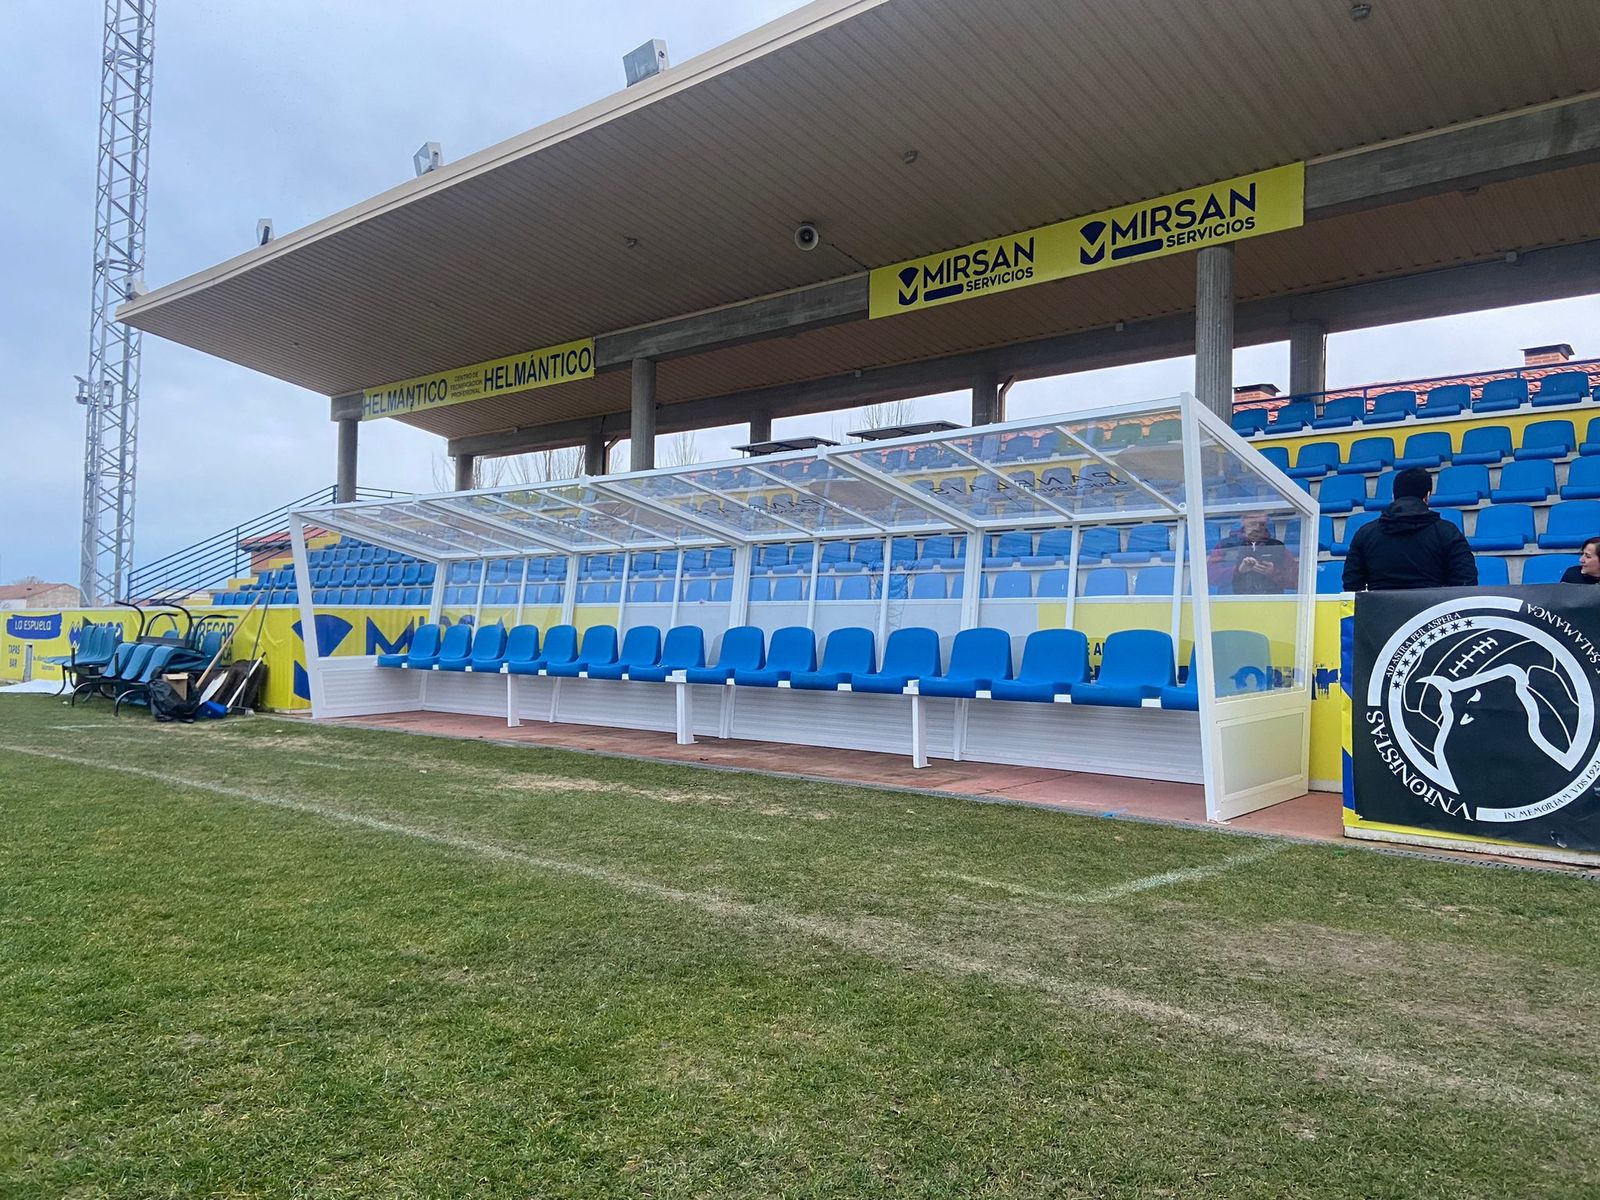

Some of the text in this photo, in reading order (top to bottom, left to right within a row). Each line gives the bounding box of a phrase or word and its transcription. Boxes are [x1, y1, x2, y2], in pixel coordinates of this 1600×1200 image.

[1112, 183, 1256, 246] MIRSAN
[1167, 217, 1256, 248] SERVICIOS
[923, 237, 1034, 289] MIRSAN
[966, 267, 1033, 292] SERVICIOS
[483, 347, 591, 393] HELMÁNTICO
[363, 378, 448, 416] HELMÁNTICO
[1386, 612, 1461, 678] AD ASTRA PER ASPERA
[1519, 793, 1572, 817] MEMORIAM
[1571, 778, 1588, 793] VDS
